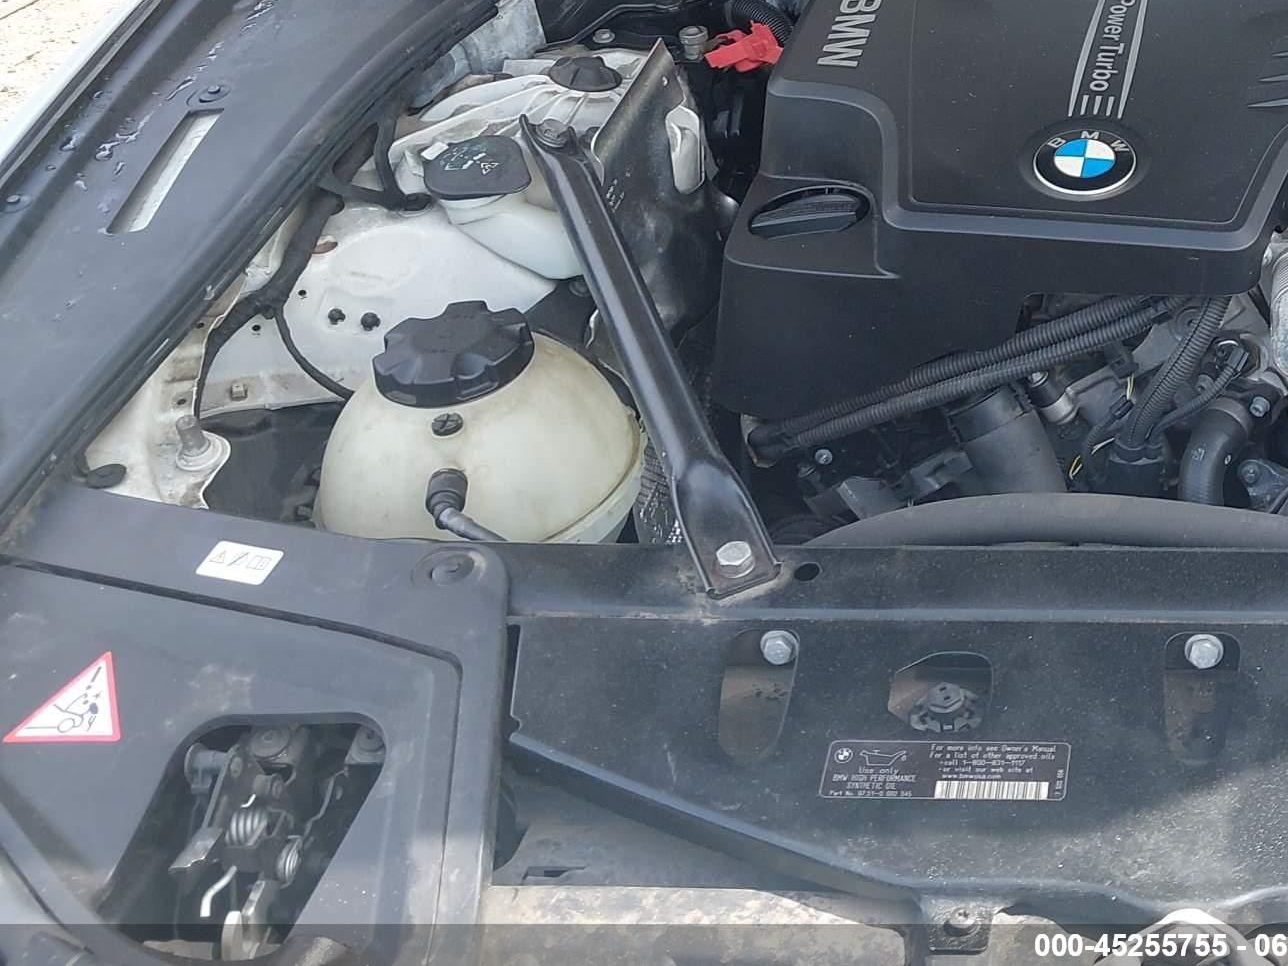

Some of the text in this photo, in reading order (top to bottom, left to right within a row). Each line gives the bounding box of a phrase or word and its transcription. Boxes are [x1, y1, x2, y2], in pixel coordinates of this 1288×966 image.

[1089, 42, 1125, 92] Turbo
[1047, 130, 1129, 153] BMW
[1001, 744, 1028, 752] Owner's
[954, 751, 967, 759] list
[1005, 752, 1038, 760] approved
[858, 765, 899, 775] Use only
[832, 774, 917, 782] BMW HIGH PERFORMANCE
[885, 782, 897, 790] OIL
